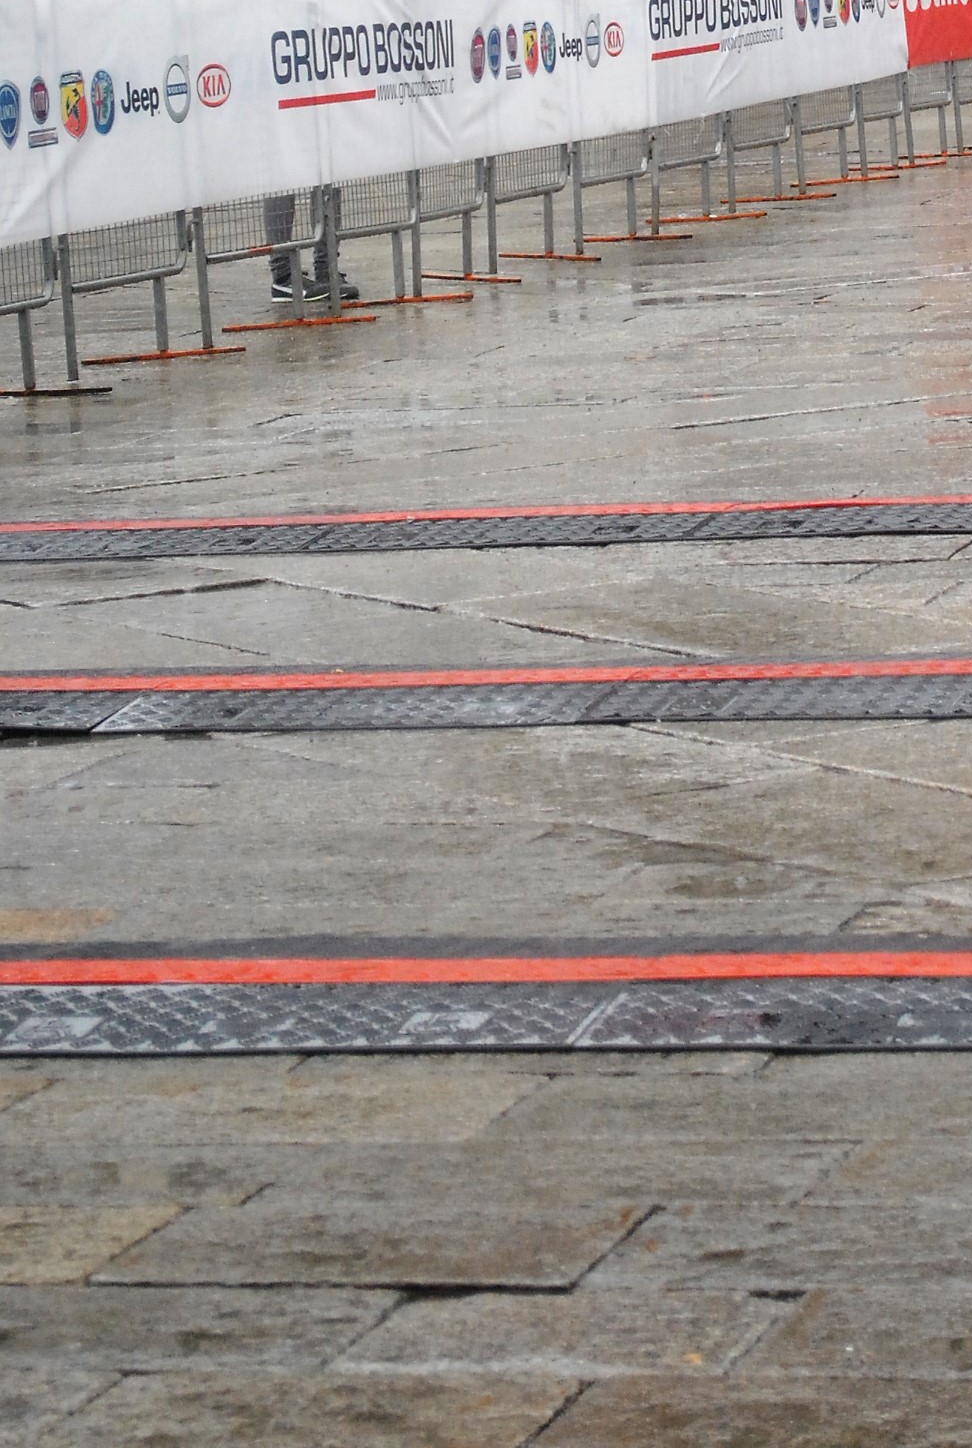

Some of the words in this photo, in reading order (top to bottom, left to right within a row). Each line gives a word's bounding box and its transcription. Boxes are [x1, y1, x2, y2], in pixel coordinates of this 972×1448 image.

[271, 24, 370, 85] GRUPPO
[373, 19, 455, 74] BOSSONI
[559, 33, 582, 62] Jeep
[606, 30, 621, 48] KIA
[121, 81, 160, 117] Jeep
[202, 74, 226, 98] KIA
